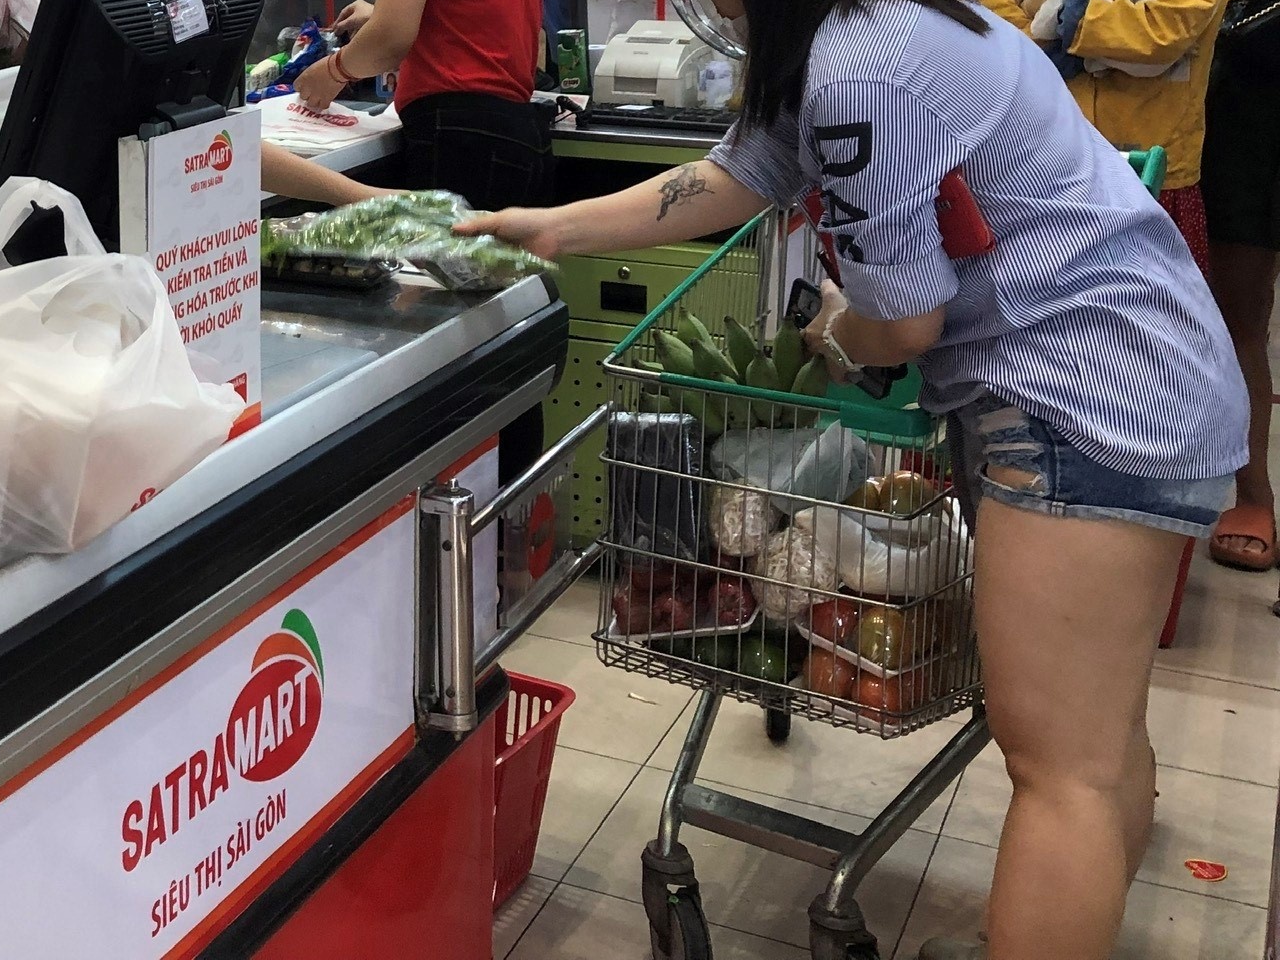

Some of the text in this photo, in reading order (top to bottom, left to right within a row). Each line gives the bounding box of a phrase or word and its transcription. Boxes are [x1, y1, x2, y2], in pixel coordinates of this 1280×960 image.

[184, 146, 231, 174] SATRAMART
[156, 219, 258, 272] QUÝ KHÁCH VUI LÒNG
[167, 266, 192, 296] KIỂM
[193, 261, 212, 284] TRA
[235, 246, 248, 268] VÀ
[186, 293, 208, 316] HÓA
[209, 276, 241, 306] TRƯỚC
[243, 270, 259, 292] KHI
[180, 321, 190, 345] ỜI
[191, 314, 216, 342] KHỎI
[121, 664, 314, 873] SATRAMART
[151, 788, 287, 939] SIÊU THỊ SÀI GÒN
